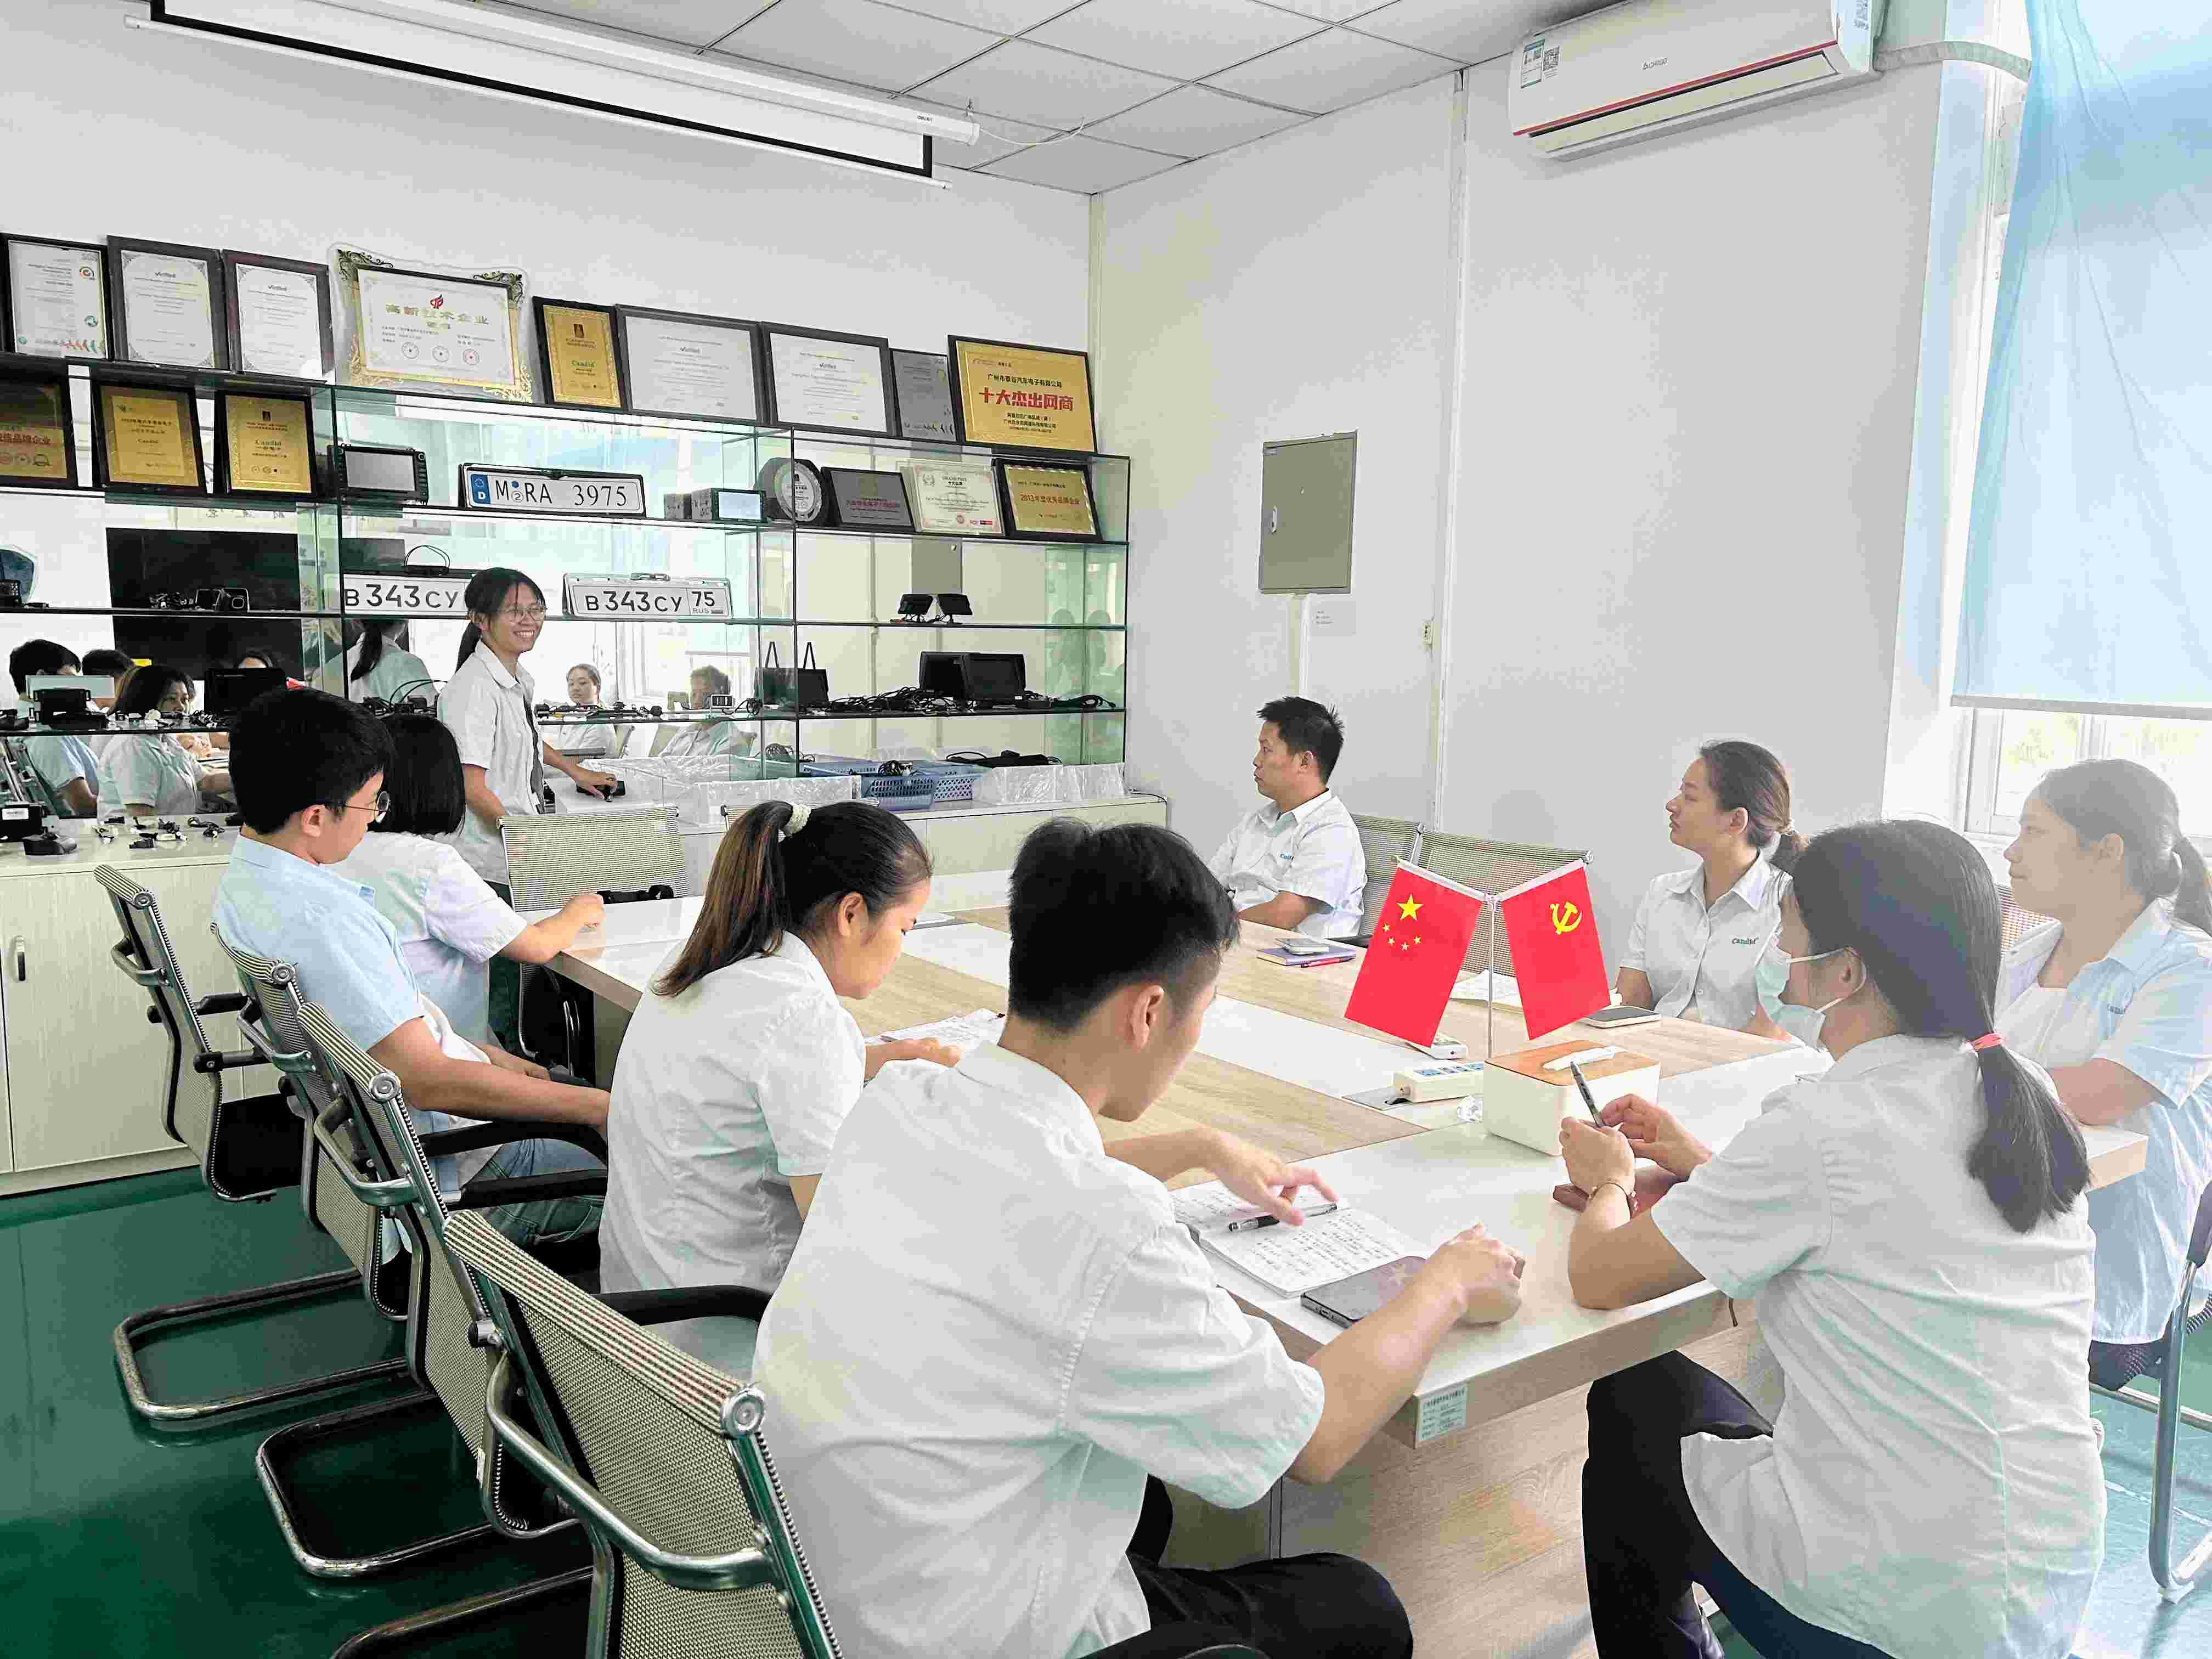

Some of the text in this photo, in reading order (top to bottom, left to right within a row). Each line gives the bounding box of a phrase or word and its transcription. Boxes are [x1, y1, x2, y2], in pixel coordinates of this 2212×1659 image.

[978, 386, 1074, 412] 十大杰出网商
[478, 491, 486, 500] D
[573, 484, 627, 506] 3975
[691, 591, 715, 607] 75
